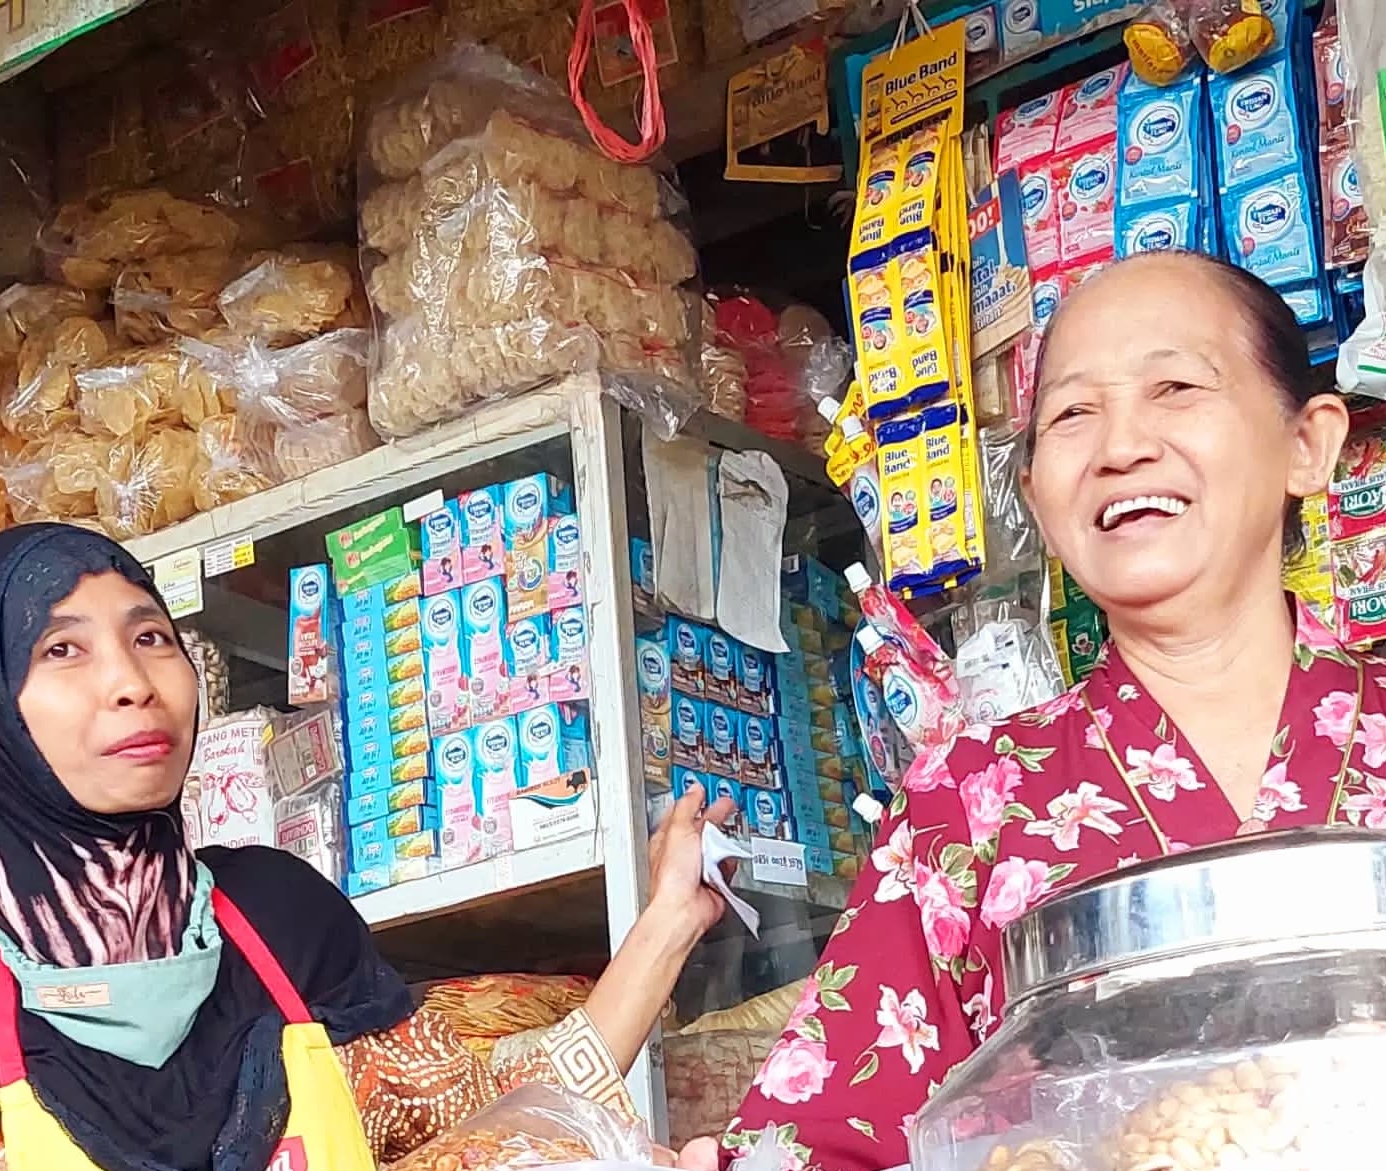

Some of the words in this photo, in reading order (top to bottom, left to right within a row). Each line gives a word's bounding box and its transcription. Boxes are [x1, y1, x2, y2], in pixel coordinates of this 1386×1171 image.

[885, 72, 917, 96] Blue
[919, 51, 958, 80] Band
[912, 349, 938, 368] Band
[925, 434, 948, 449] Blue
[884, 448, 908, 463] Blue
